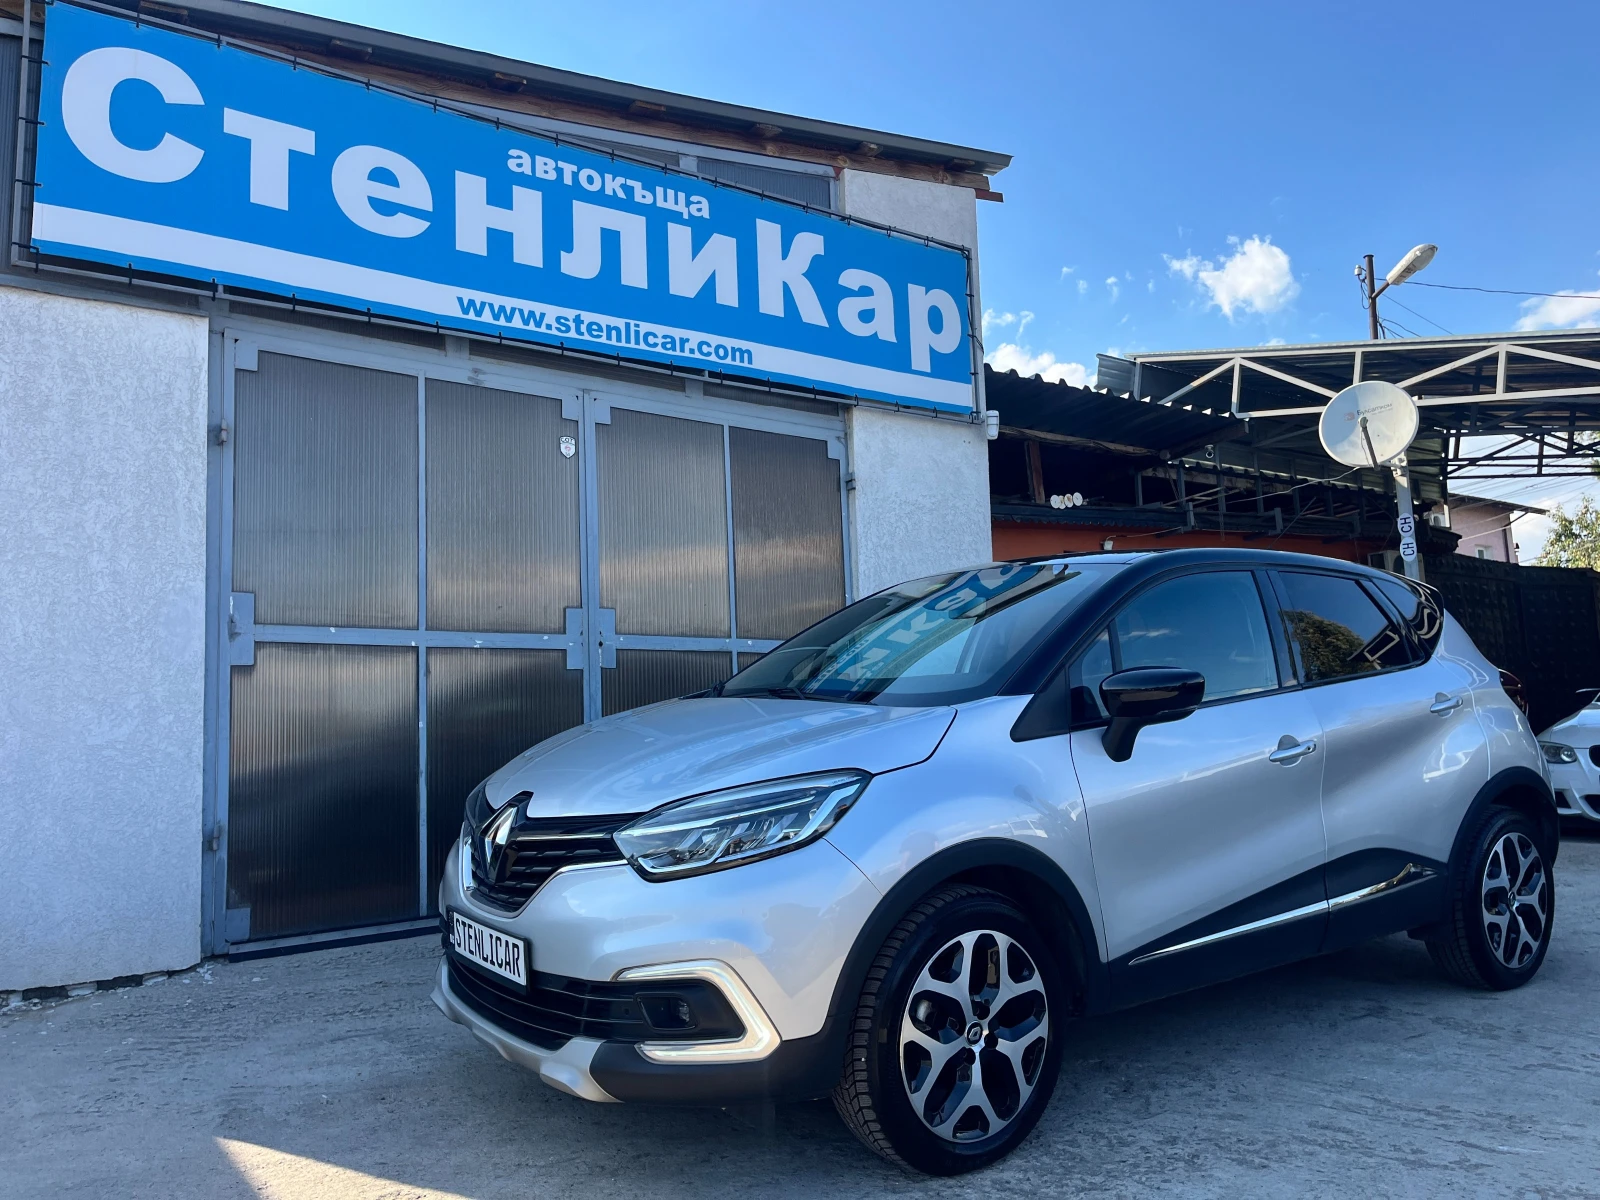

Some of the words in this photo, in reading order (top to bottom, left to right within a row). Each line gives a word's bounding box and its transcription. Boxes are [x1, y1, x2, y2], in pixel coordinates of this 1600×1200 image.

[61, 47, 962, 372] СтенлиКар
[507, 149, 710, 220] автокъща
[457, 296, 754, 366] www.stenlicar.com
[1400, 516, 1412, 533] CH
[1402, 542, 1415, 556] CH
[455, 917, 521, 978] STENLICAR
